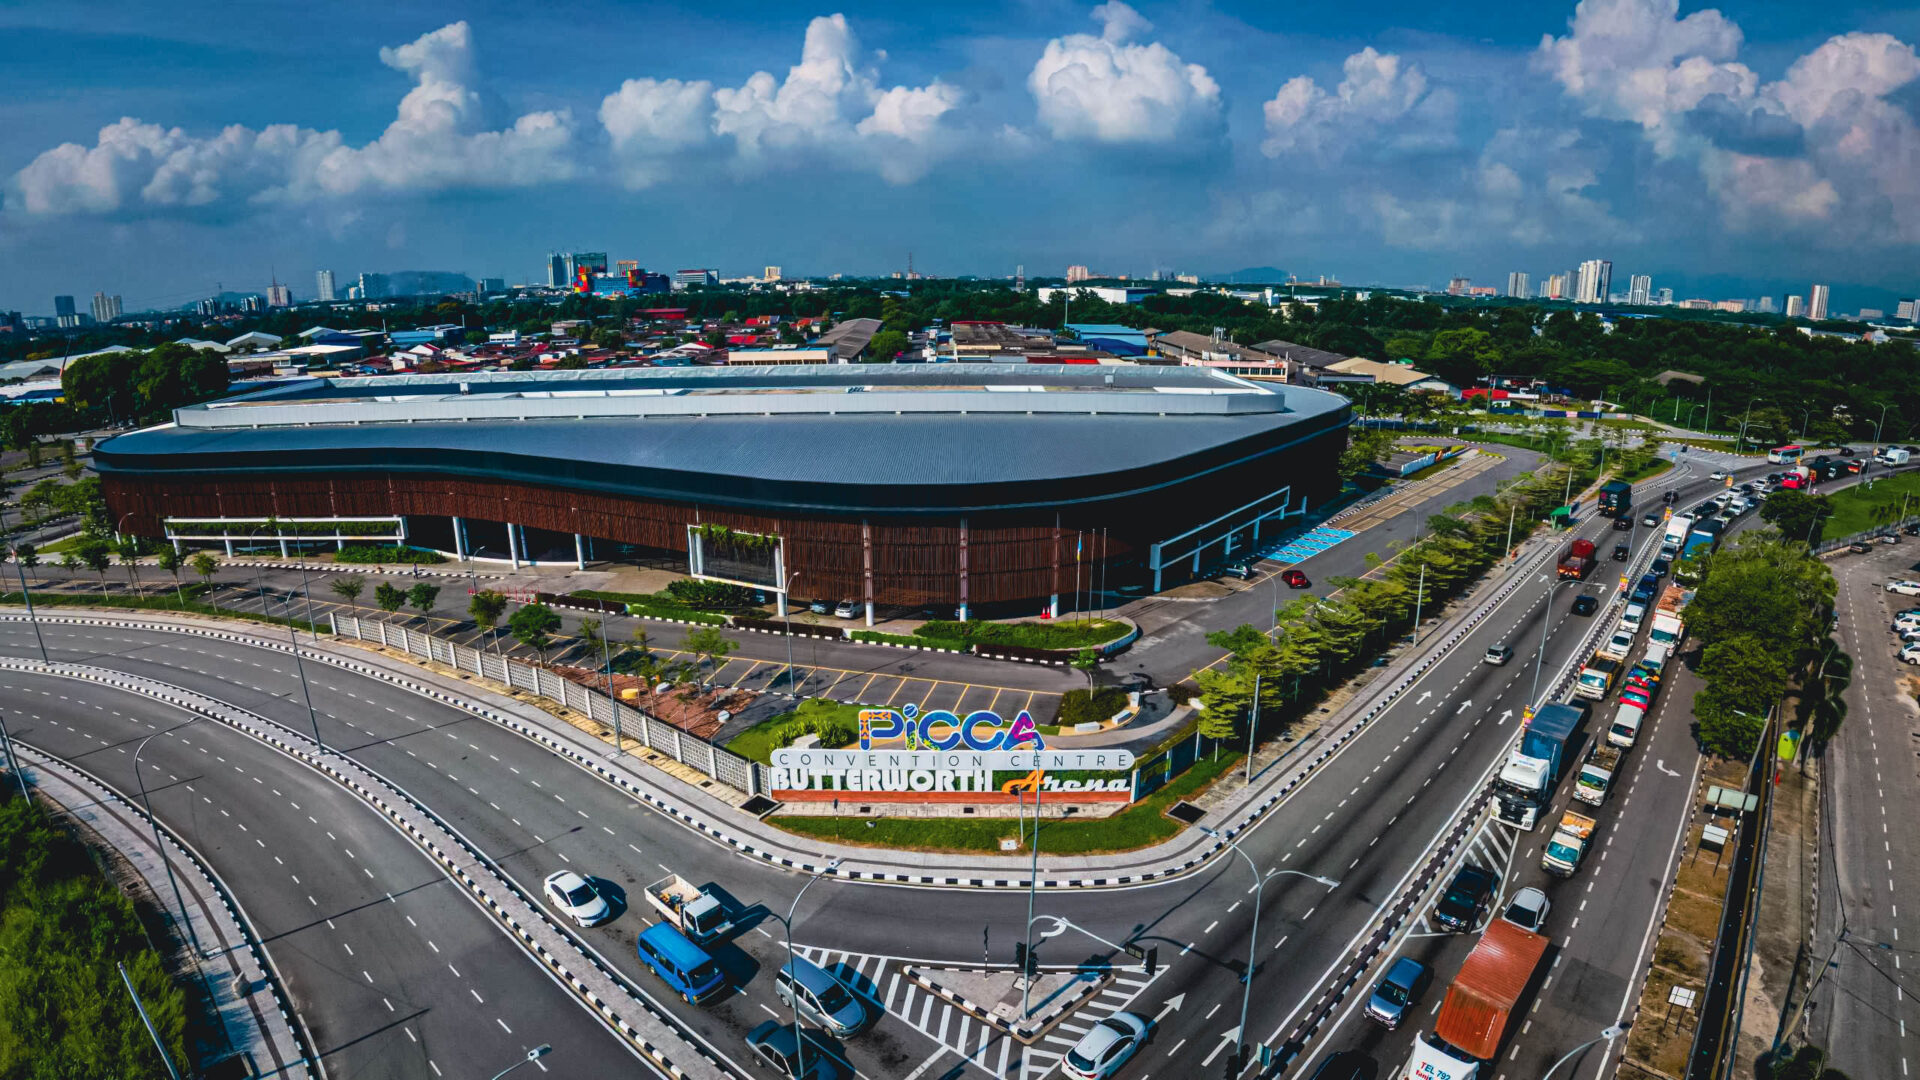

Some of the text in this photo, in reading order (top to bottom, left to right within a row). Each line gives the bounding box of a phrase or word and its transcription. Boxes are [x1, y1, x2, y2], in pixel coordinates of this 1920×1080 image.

[779, 753, 1128, 767] CONVENTION CENTRE
[771, 767, 1131, 794] BUTTERWORTH Arena
[1421, 1062, 1434, 1075] TEL
